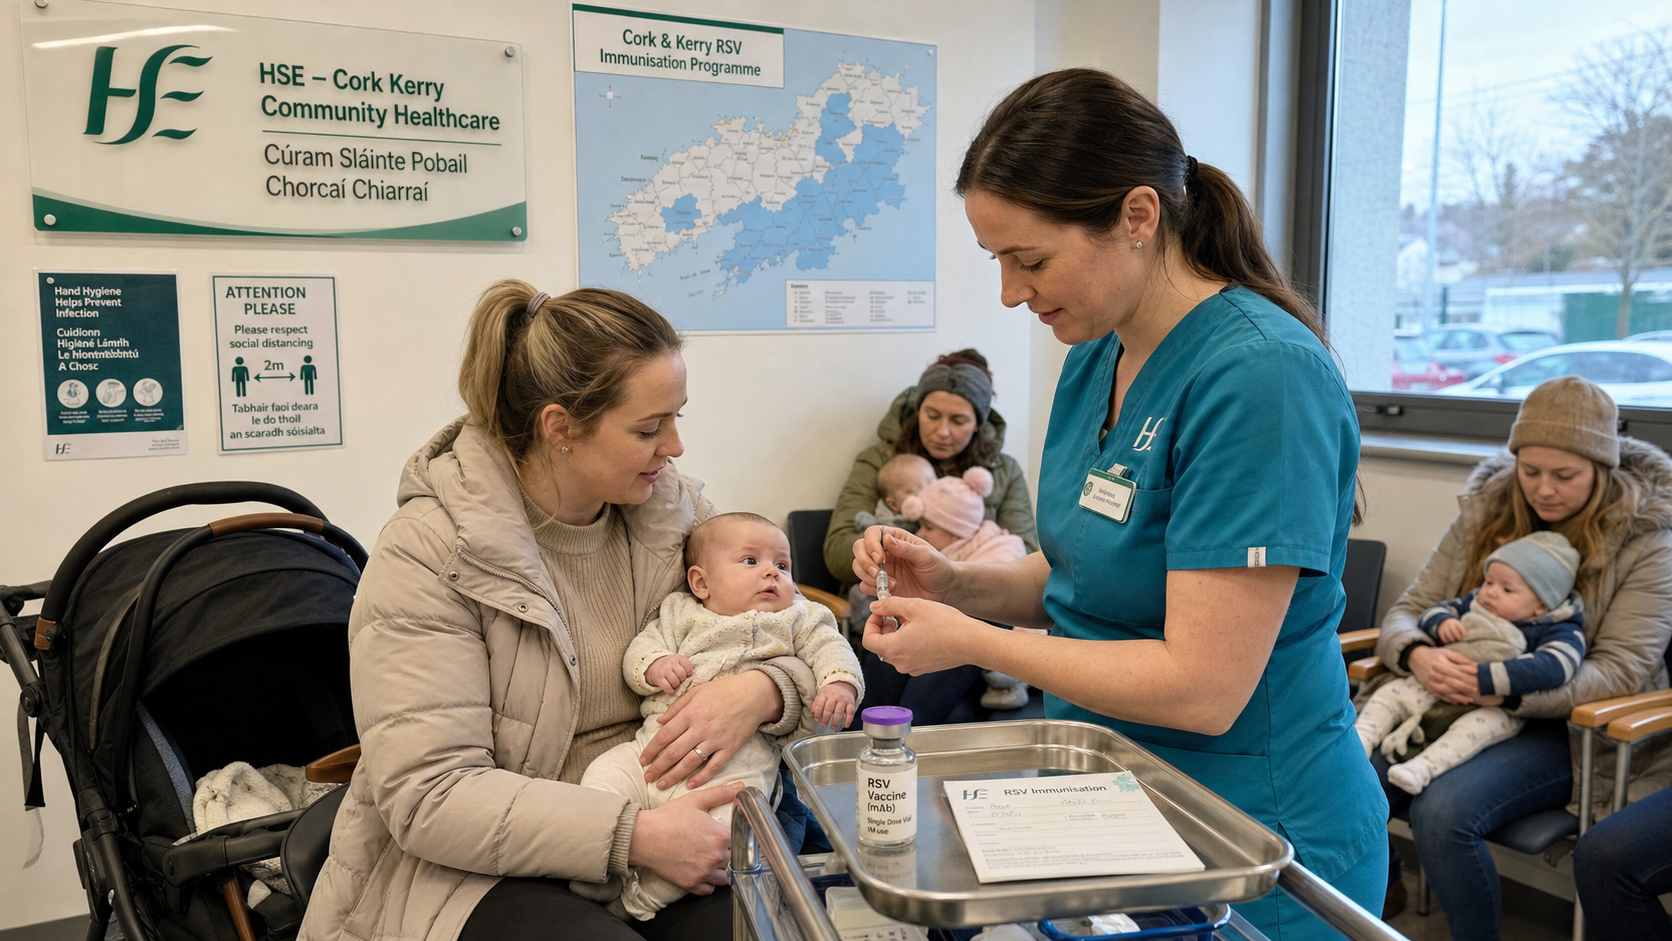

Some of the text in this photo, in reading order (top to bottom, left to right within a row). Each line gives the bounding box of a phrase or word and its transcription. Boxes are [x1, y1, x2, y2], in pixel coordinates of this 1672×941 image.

[622, 29, 742, 56] Cork & Kerry RSV
[600, 49, 761, 76] Immunisation Programme
[259, 62, 305, 87] HSE
[333, 68, 383, 93] Cork
[390, 73, 444, 102] Kerry
[83, 44, 213, 145] HSE
[261, 95, 500, 131] Community Healthcare
[264, 143, 467, 173] Cúram Sláinte Pobail
[266, 175, 428, 201] Chorcaí Chiarraí
[54, 286, 122, 298] Hand Hygiene
[226, 286, 306, 299] ATTENTION
[55, 298, 122, 308] Helps Prevent
[244, 303, 296, 315] PLEASE
[56, 308, 99, 317] Infection
[234, 325, 308, 336] Please respect
[230, 338, 313, 349] social distancing
[58, 350, 70, 359] Le
[58, 361, 99, 371] A Chosc
[264, 360, 284, 371] 2m
[232, 402, 318, 413] Tabhair faoi deara
[252, 414, 301, 425] le do thoil
[230, 426, 325, 439] an scaradh sóisialta
[867, 778, 890, 789] RSV
[867, 790, 907, 801] Vaccine
[1004, 788, 1027, 797] RSV
[1031, 785, 1107, 795] Immunisation
[867, 802, 896, 814] (mAb)
[887, 818, 902, 826] Dose
